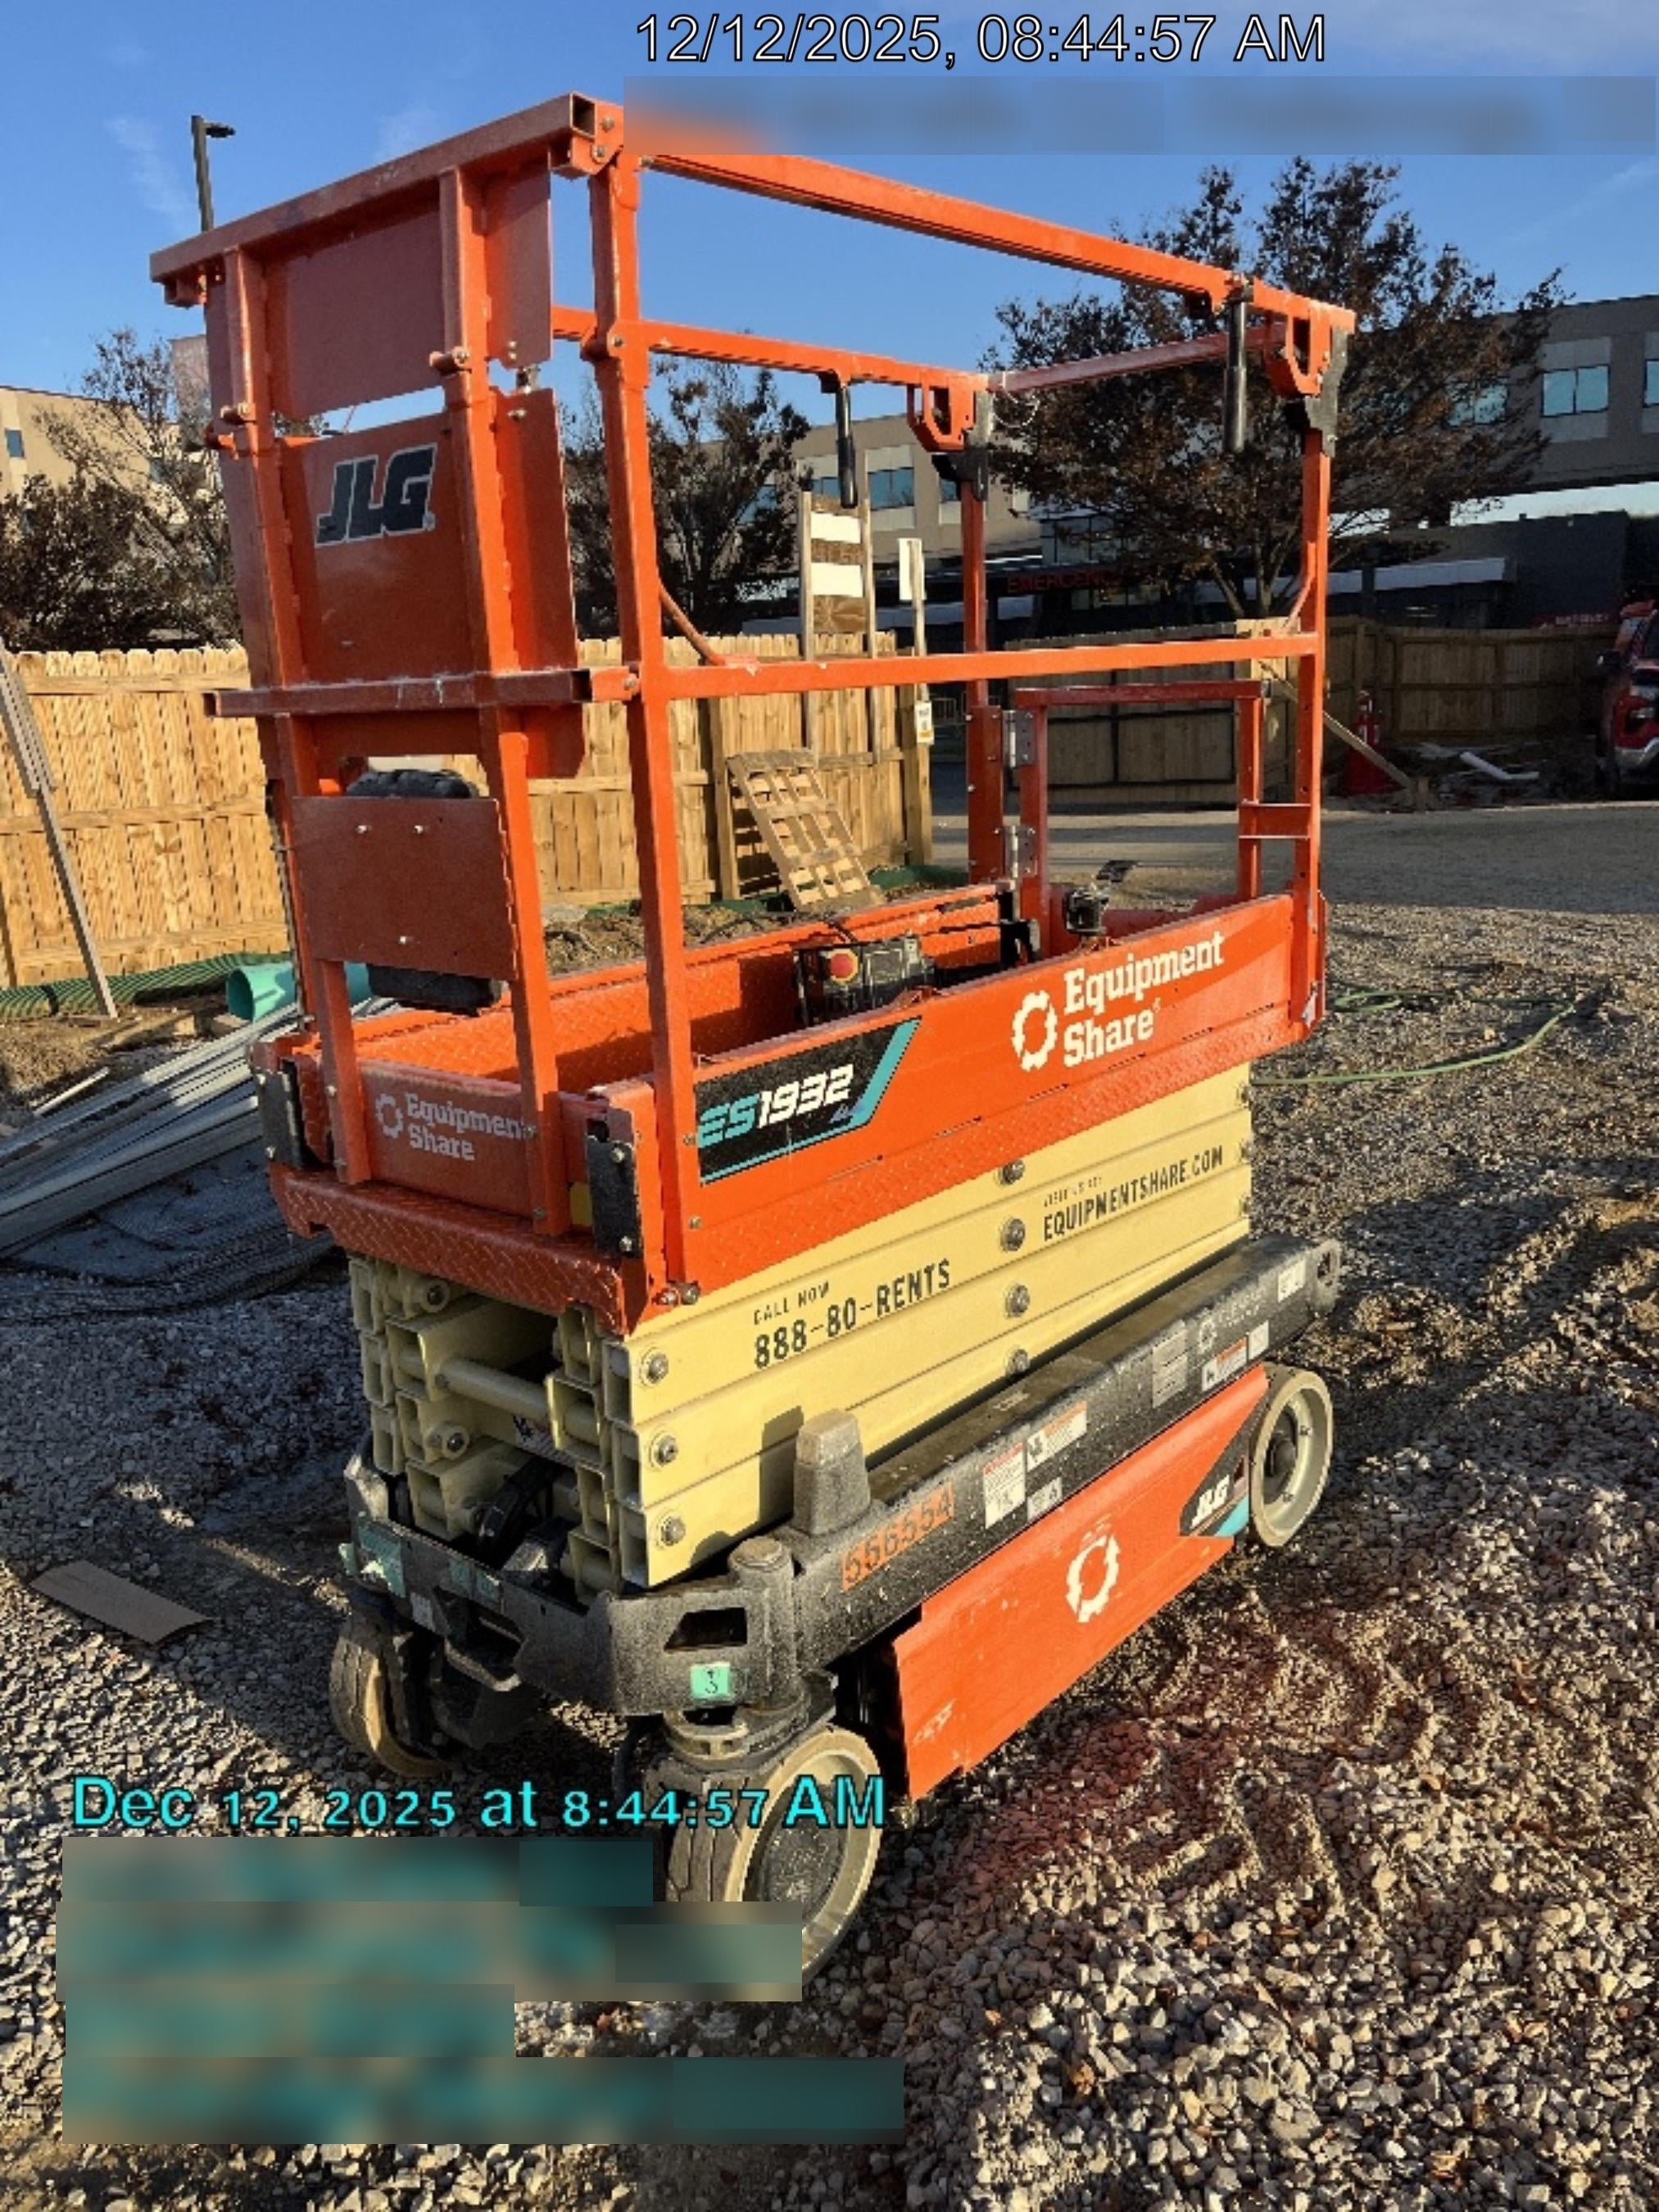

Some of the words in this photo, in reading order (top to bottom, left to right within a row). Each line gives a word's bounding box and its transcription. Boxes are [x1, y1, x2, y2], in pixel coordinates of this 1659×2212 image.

[315, 442, 437, 548] JLG
[1063, 930, 1225, 1016] Equipment
[408, 1123, 475, 1160] Share
[697, 1063, 854, 1149] ES1932
[1043, 1145, 1223, 1241] EQUIPMENTSHARE.COM
[754, 1298, 790, 1325] CALL
[798, 1281, 830, 1308] NOW
